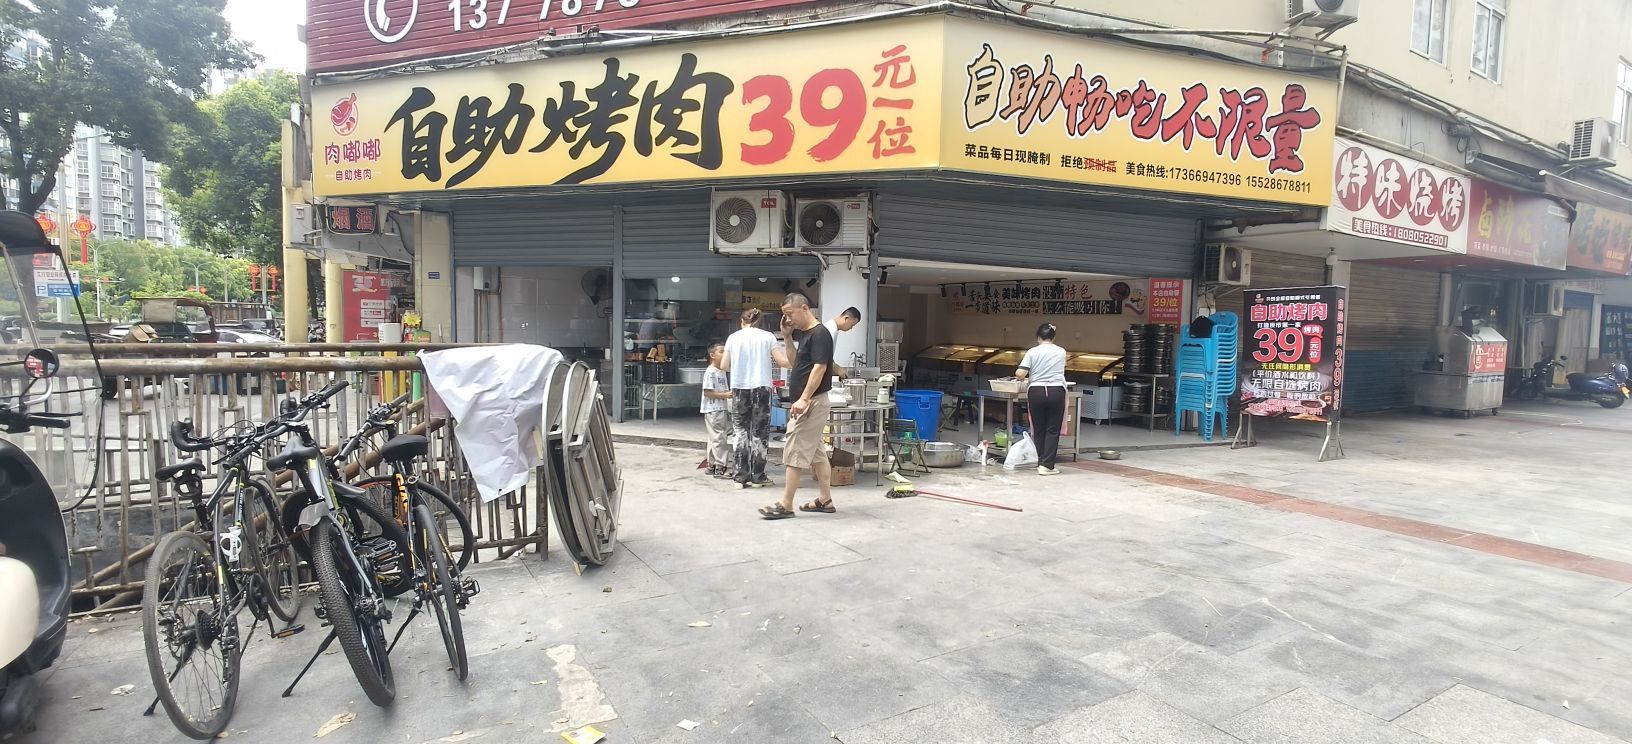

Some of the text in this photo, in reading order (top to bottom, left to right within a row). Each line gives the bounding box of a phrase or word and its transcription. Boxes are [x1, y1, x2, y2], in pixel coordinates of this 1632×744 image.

[383, 53, 867, 188] 自助烤肉 39
[964, 43, 1320, 174] 自助畅吃不限量
[325, 139, 381, 165] 肉嘟嘟
[336, 169, 372, 181] 自助烤肉
[965, 144, 1050, 166] 菜品每日现腌制
[1246, 175, 1311, 193] 15528678811
[1337, 151, 1463, 227] 特味烧烤
[331, 207, 374, 230] 烟酒
[1153, 298, 1178, 307] 39/位
[1251, 302, 1328, 321] 自助烤肉
[1252, 328, 1304, 362] 39
